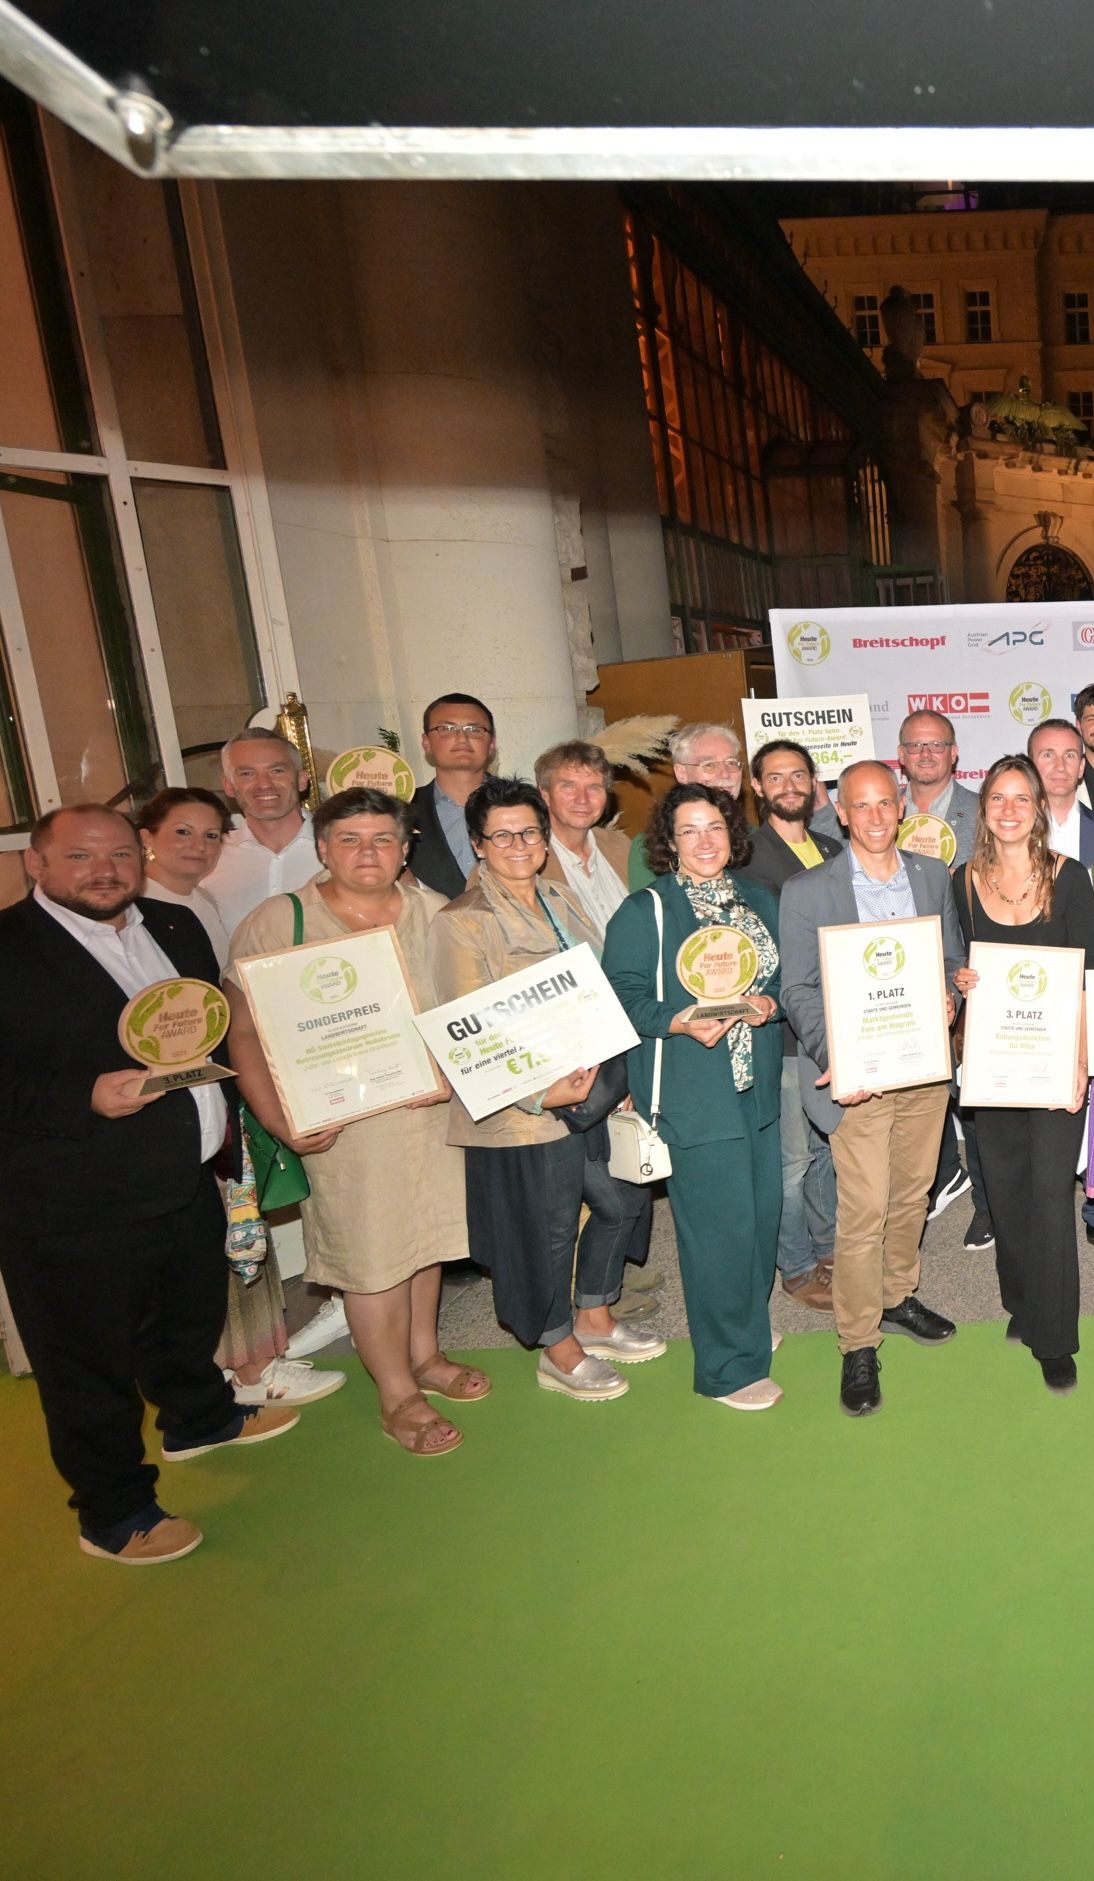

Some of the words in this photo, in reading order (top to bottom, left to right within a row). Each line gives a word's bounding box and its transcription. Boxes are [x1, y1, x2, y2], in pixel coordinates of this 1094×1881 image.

[852, 635, 948, 650] Breitschopf
[988, 630, 1045, 647] APG
[760, 708, 853, 728] GUTSCHEIN
[355, 771, 389, 780] Heute
[911, 835, 936, 843] Heute
[703, 952, 734, 961] Heute
[705, 967, 733, 976] AWARD
[868, 992, 875, 1000] 1.
[877, 987, 905, 1000] PLATZ
[159, 1008, 198, 1022] Heute
[296, 1002, 382, 1033] SONDERPREIS
[697, 1008, 749, 1019] LANDWIRTSCHAFT
[862, 1011, 914, 1024] Marktgemeinde
[1006, 1010, 1014, 1019] 3.
[1015, 1010, 1043, 1020] PLATZ
[153, 1024, 170, 1033] For
[172, 1017, 203, 1027] Future
[160, 1026, 198, 1039] AWARD
[320, 1024, 368, 1041] LANDWIRTSCHAFT
[479, 1041, 504, 1056] Heute
[460, 1065, 473, 1077] für
[474, 1057, 493, 1070] eine
[493, 1046, 518, 1062] viertel
[174, 1070, 204, 1082] PLATZ
